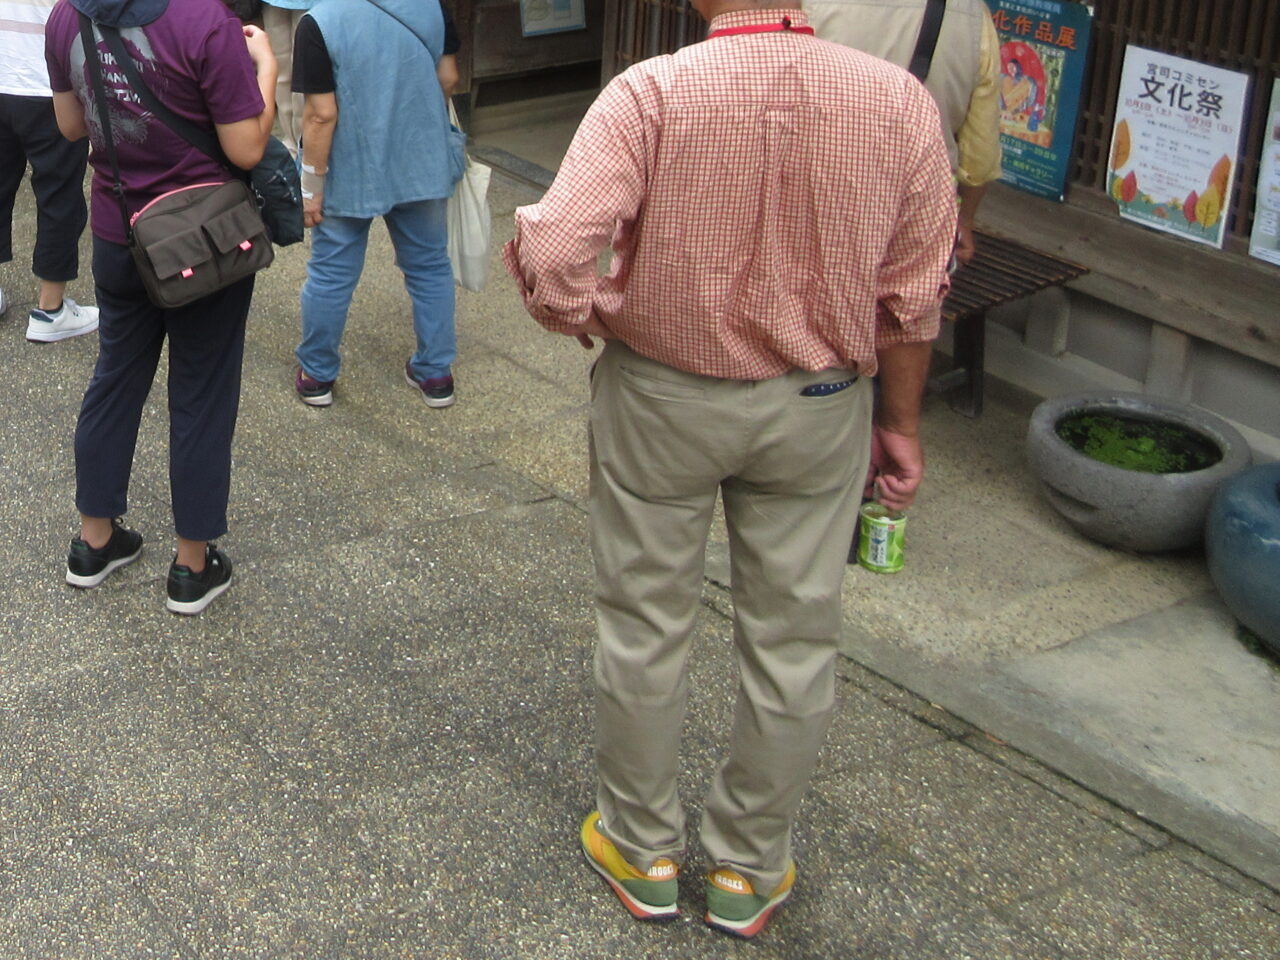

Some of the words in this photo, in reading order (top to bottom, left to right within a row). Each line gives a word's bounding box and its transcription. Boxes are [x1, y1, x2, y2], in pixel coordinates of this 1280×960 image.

[1146, 62, 1220, 90] 宮司コミセン
[1138, 76, 1224, 120] 文化祭
